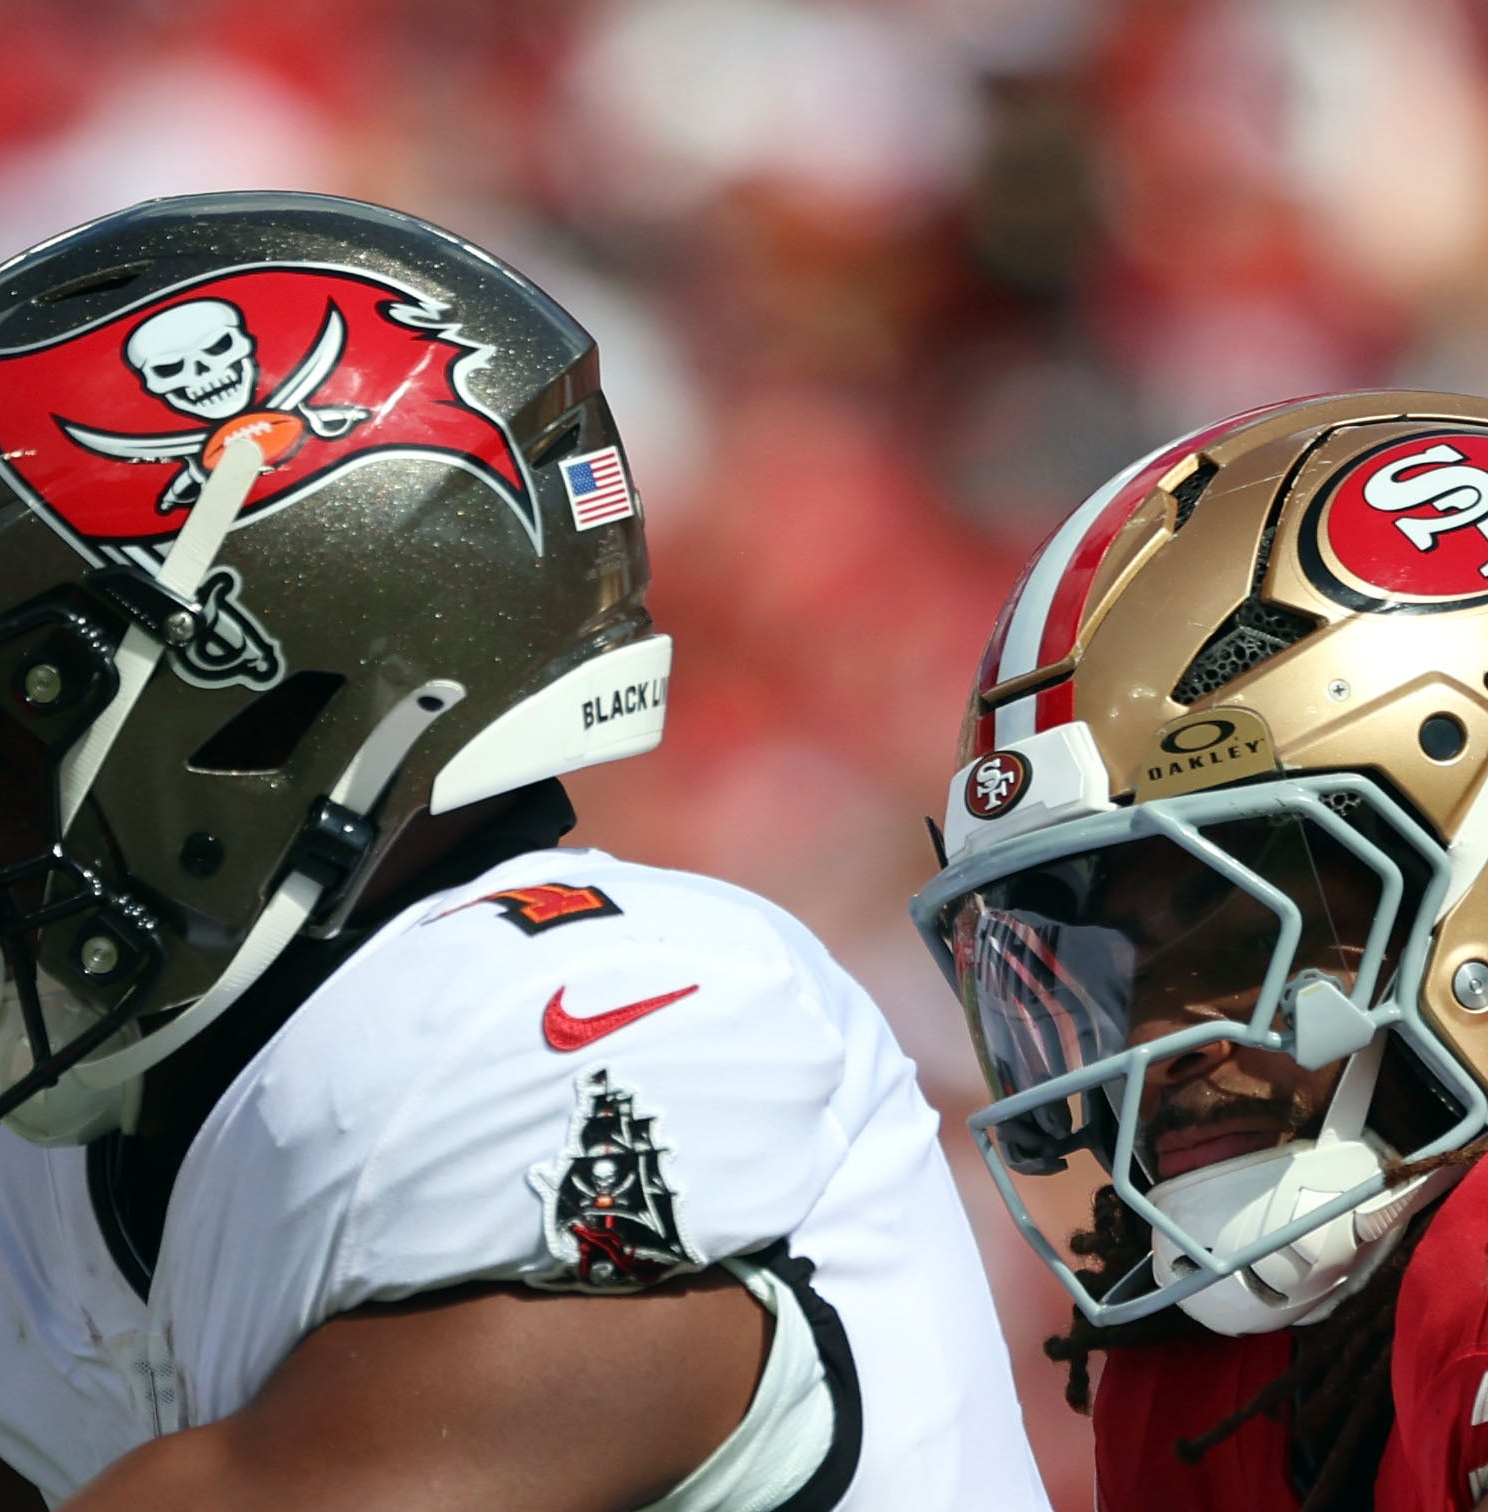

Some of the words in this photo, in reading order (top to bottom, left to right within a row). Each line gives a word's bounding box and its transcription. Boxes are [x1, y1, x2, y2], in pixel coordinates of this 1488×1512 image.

[582, 681, 649, 731] BLACK
[976, 758, 1014, 810] SF
[1148, 739, 1263, 781] OAKLEY
